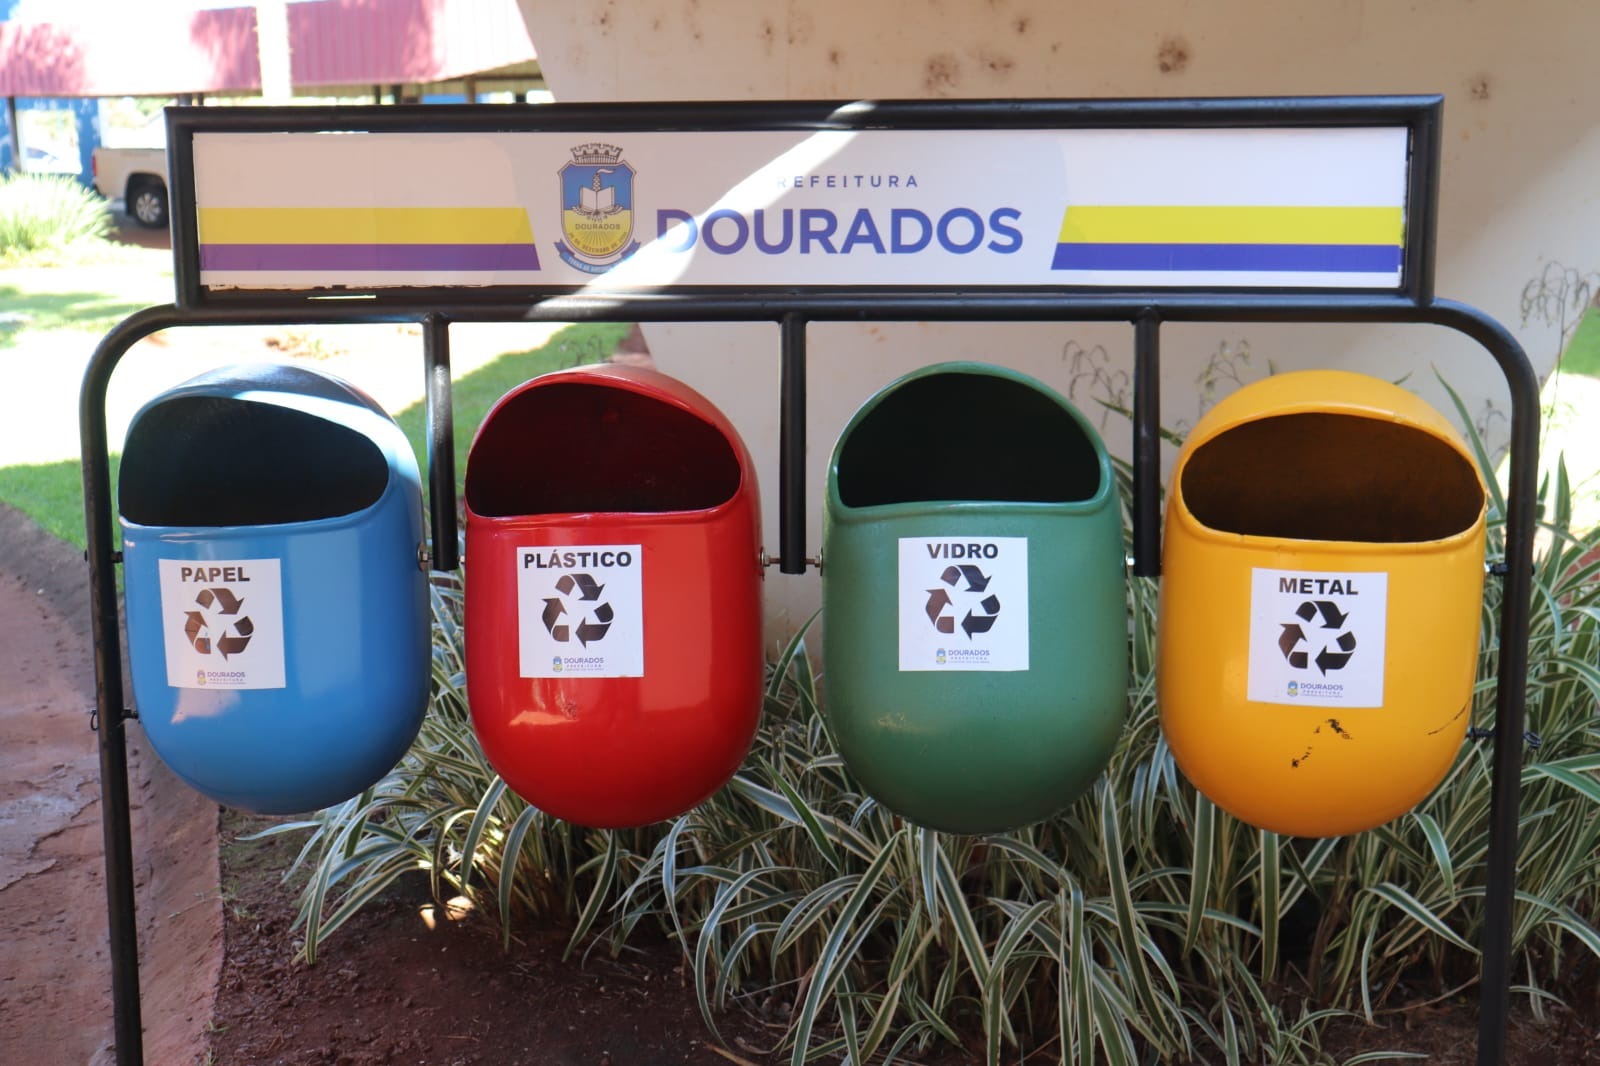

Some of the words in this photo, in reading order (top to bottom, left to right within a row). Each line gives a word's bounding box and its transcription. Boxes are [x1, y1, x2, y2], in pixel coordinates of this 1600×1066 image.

[776, 175, 920, 188] REFEITURA
[656, 207, 1024, 256] DOURADOS
[524, 549, 632, 569] PLÁSTICO
[926, 543, 998, 559] VIDRO
[181, 567, 250, 582] PAPEL
[1279, 577, 1359, 595] METAL
[1301, 683, 1343, 691] DOURADOS
